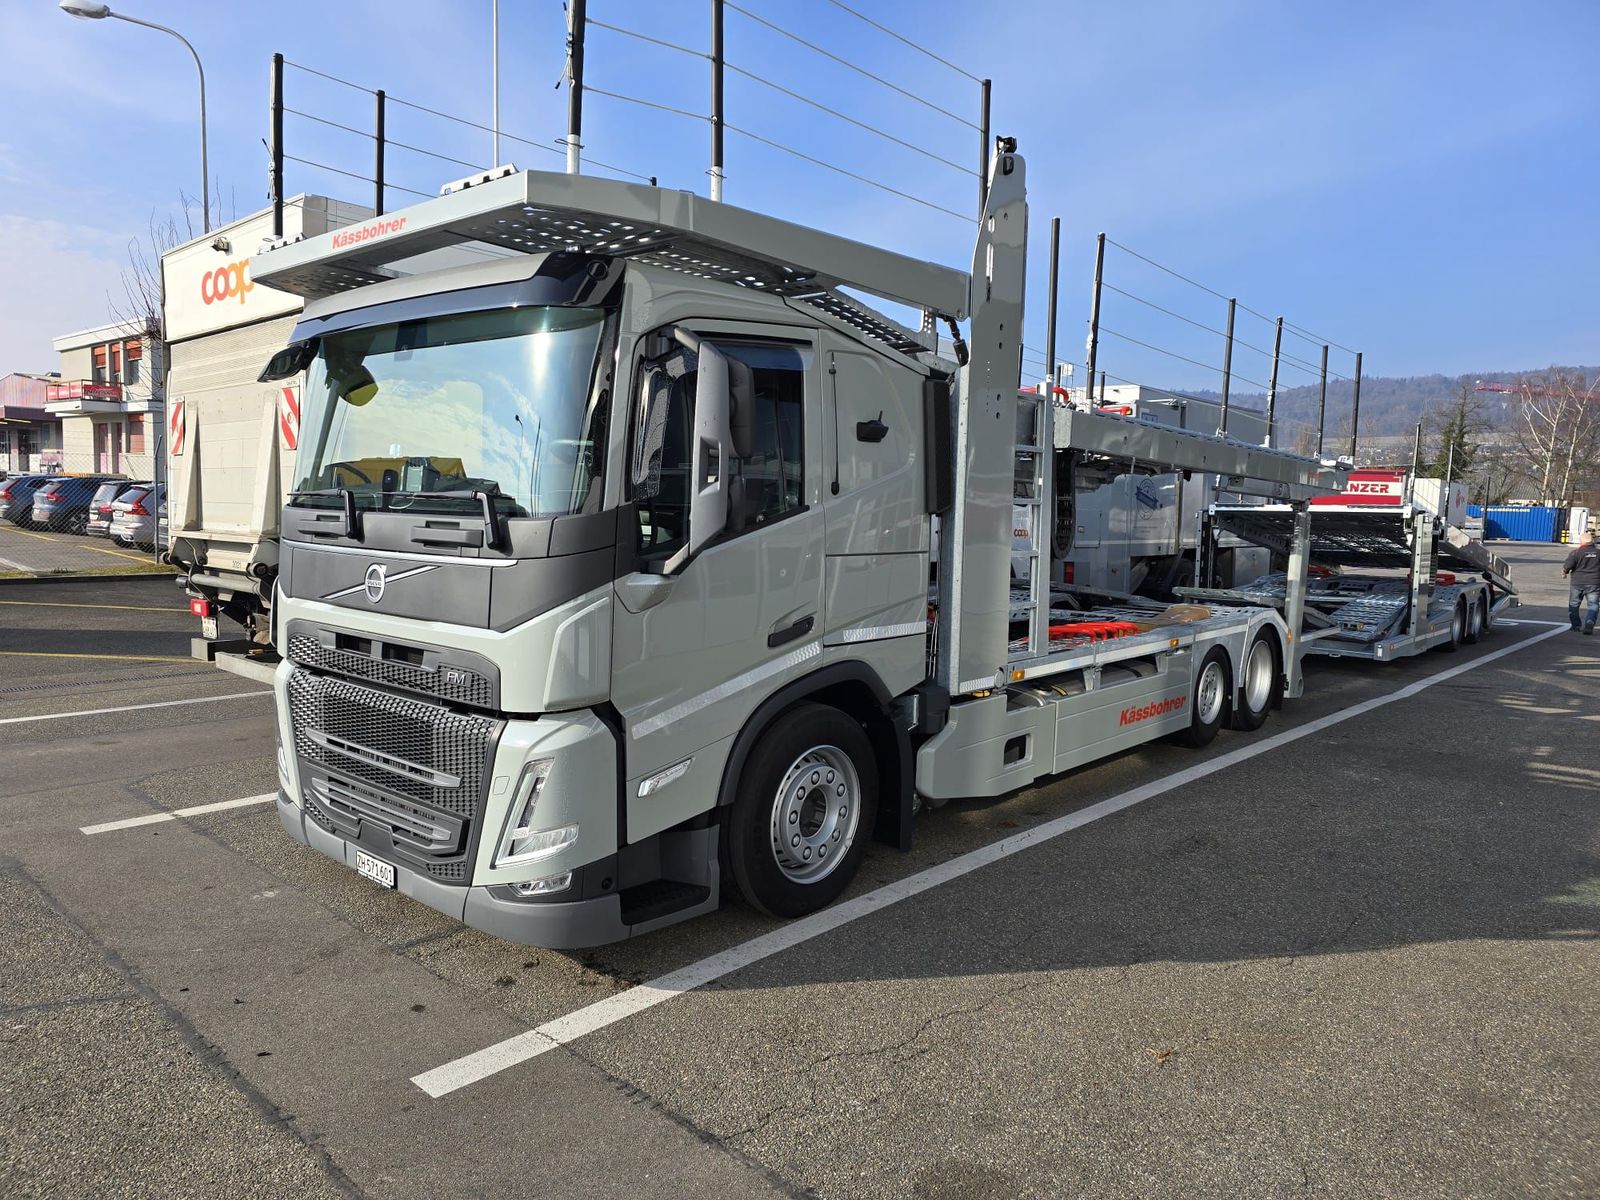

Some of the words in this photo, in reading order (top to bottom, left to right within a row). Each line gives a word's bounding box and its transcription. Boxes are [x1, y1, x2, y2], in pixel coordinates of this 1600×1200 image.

[332, 216, 407, 250] Kässbohrer
[201, 257, 255, 305] coop
[1345, 482, 1390, 494] NZER
[1013, 528, 1029, 539] coop
[446, 671, 465, 685] FM
[1119, 694, 1187, 727] Kässbohrer
